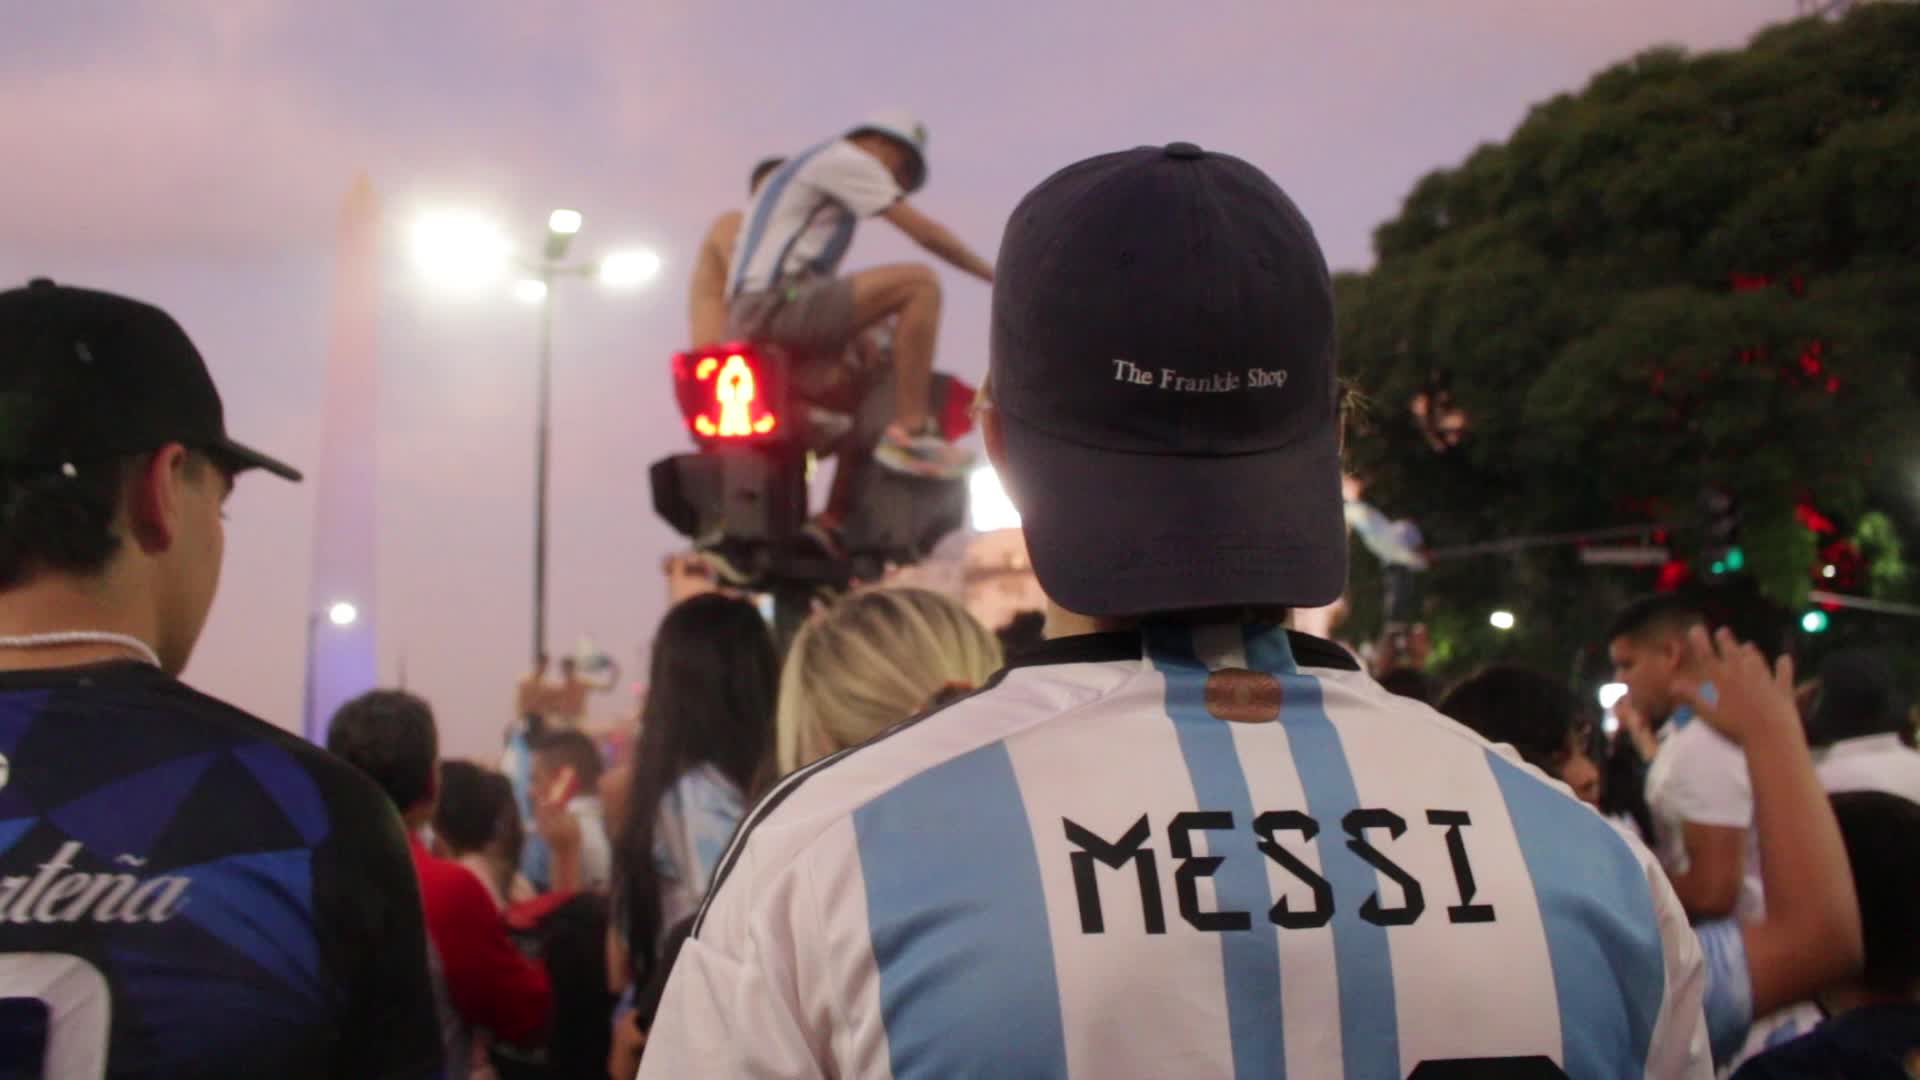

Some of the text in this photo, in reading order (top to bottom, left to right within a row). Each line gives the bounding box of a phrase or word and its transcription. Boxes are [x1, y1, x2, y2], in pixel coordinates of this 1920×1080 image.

[1112, 358, 1288, 392] The Frankie Shop
[1061, 808, 1496, 935] MESSI
